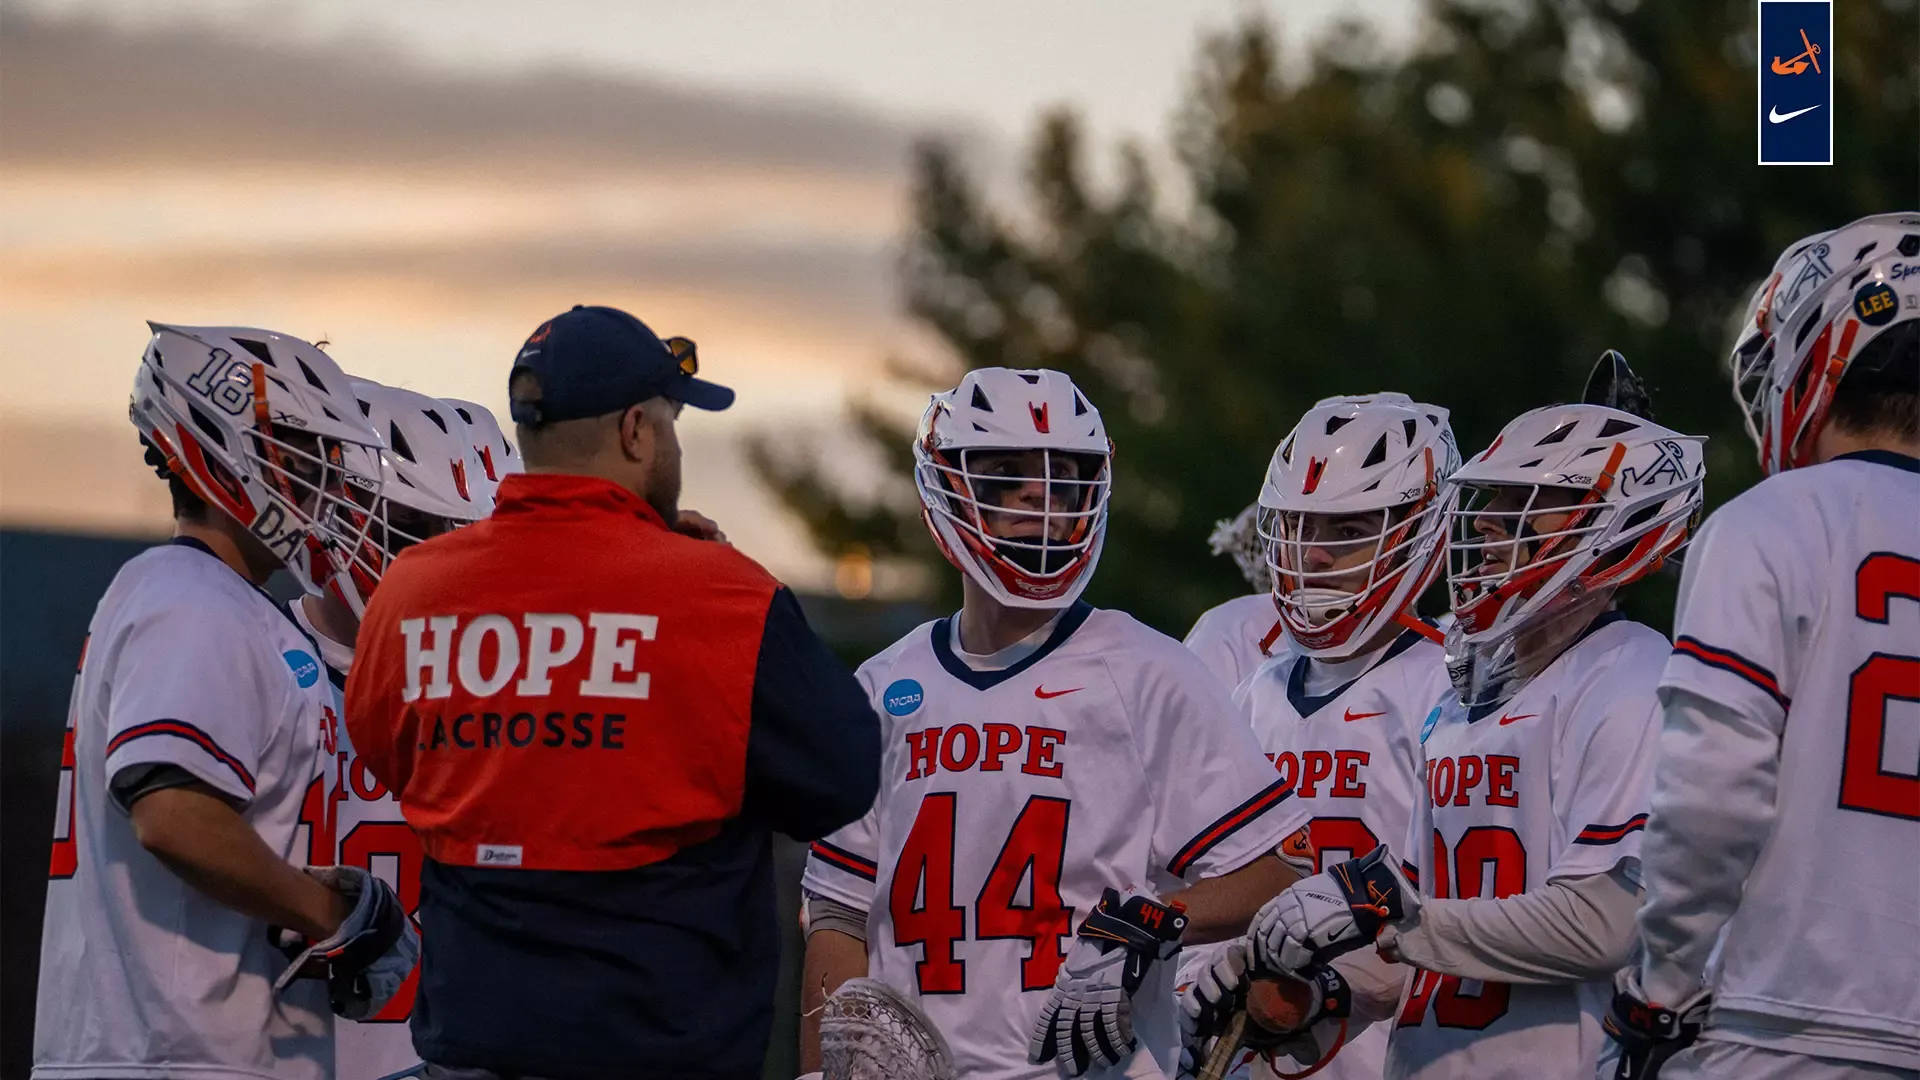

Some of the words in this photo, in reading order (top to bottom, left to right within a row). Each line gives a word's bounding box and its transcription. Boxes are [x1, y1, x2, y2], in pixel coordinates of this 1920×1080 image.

[1859, 291, 1895, 317] LEE
[186, 347, 256, 416] 18
[401, 612, 659, 702] HOPE
[889, 693, 921, 708] NCAA
[418, 712, 627, 751] ACROSSE
[906, 722, 1067, 782] HOPE
[1264, 749, 1371, 798] OPE
[889, 791, 1076, 996] 44
[1140, 902, 1165, 929] 44
